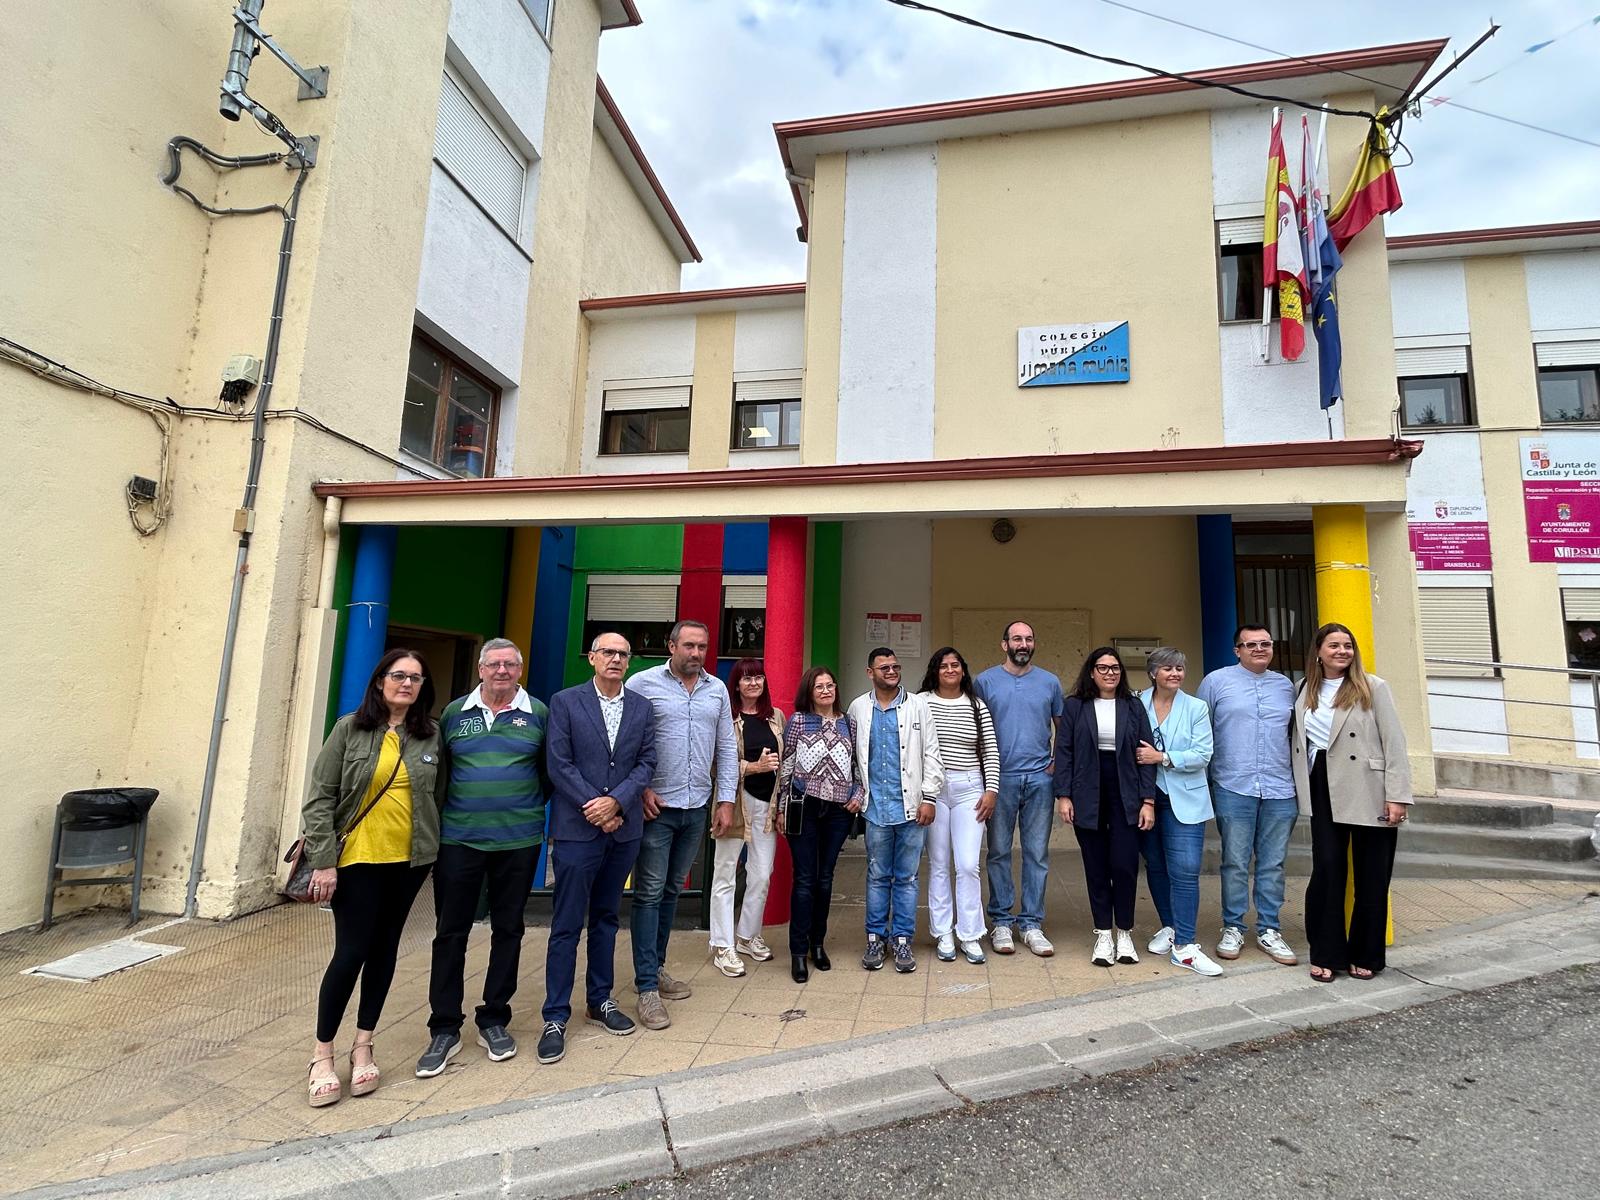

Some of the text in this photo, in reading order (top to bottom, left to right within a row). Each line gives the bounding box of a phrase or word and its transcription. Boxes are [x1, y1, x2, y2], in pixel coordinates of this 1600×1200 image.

[1526, 469, 1561, 477] Castilla
[1564, 470, 1570, 478] y
[459, 716, 483, 736] 76
